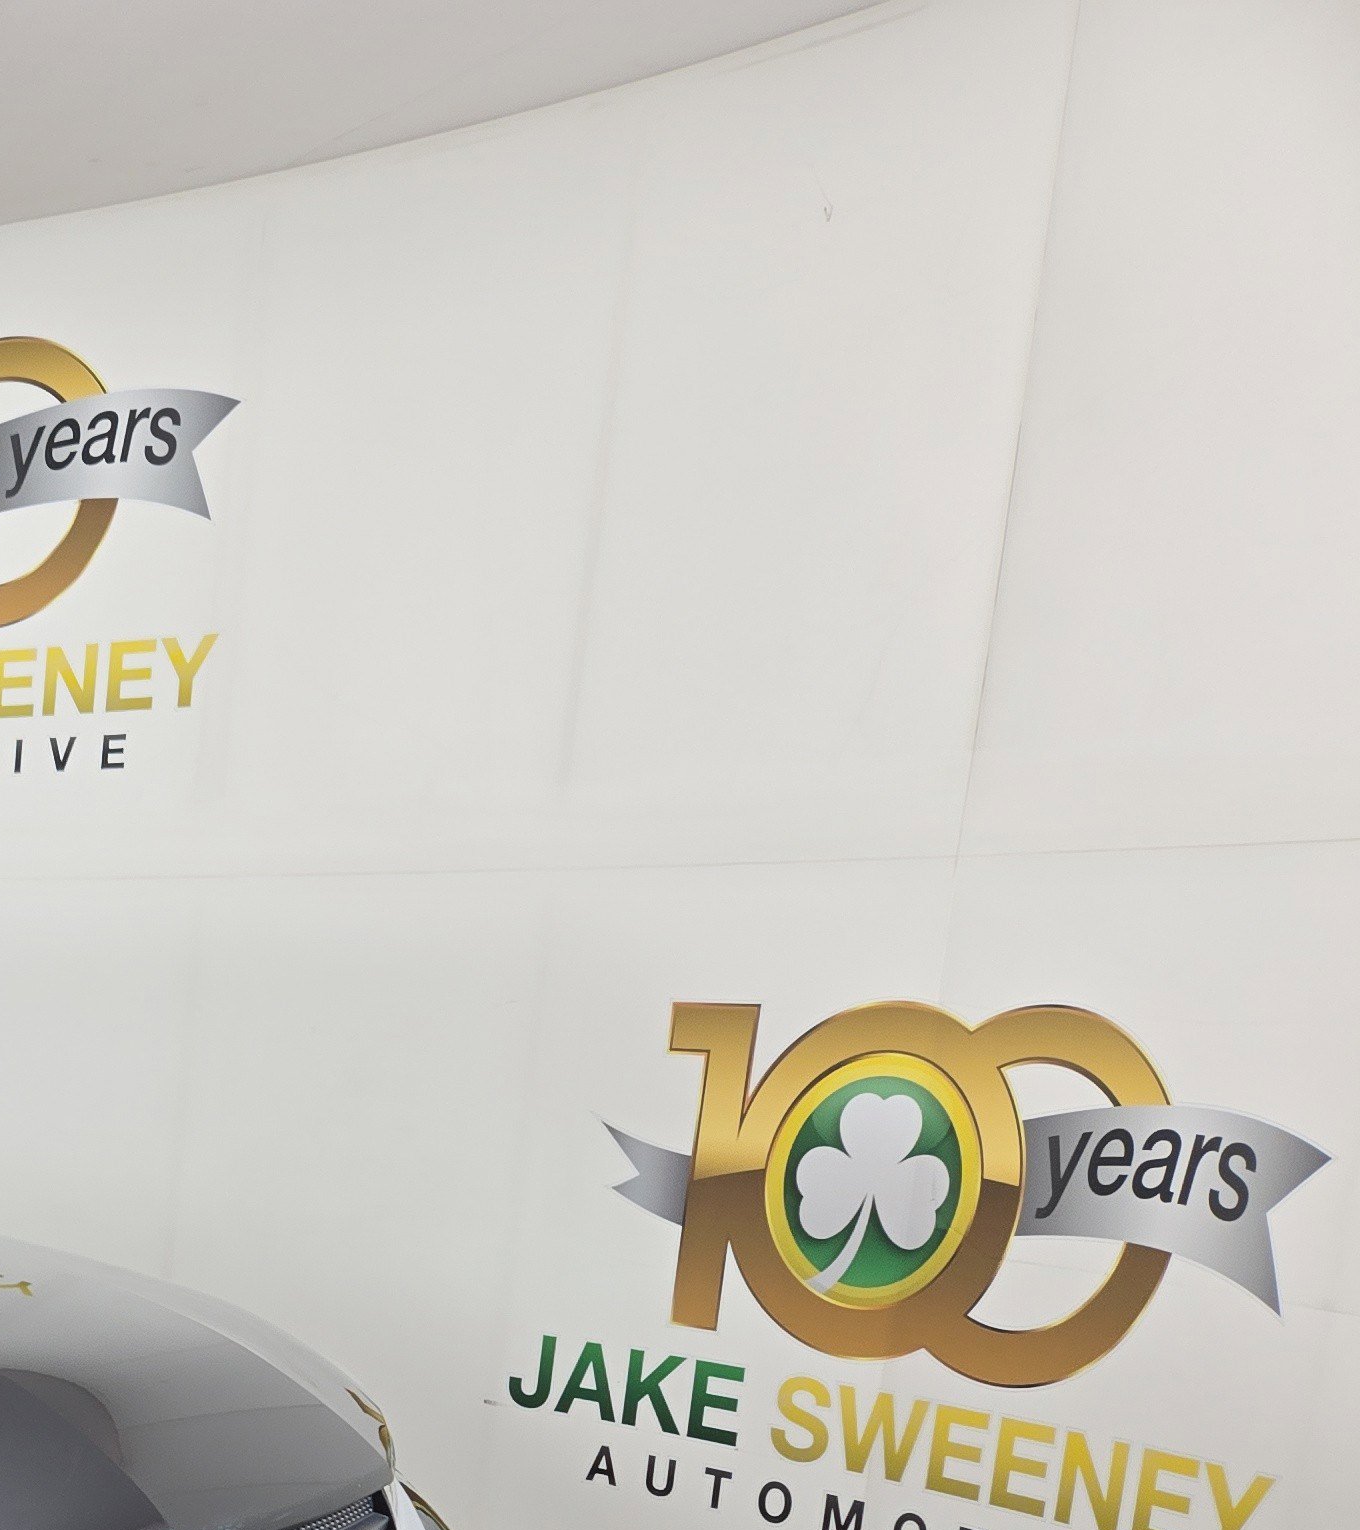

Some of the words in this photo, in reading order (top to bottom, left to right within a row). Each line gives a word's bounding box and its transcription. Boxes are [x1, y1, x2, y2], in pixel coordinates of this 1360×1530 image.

[4, 407, 180, 497] years
[669, 1000, 1171, 1388] 100
[1035, 1125, 1257, 1221] years
[508, 1335, 745, 1447] JAKE
